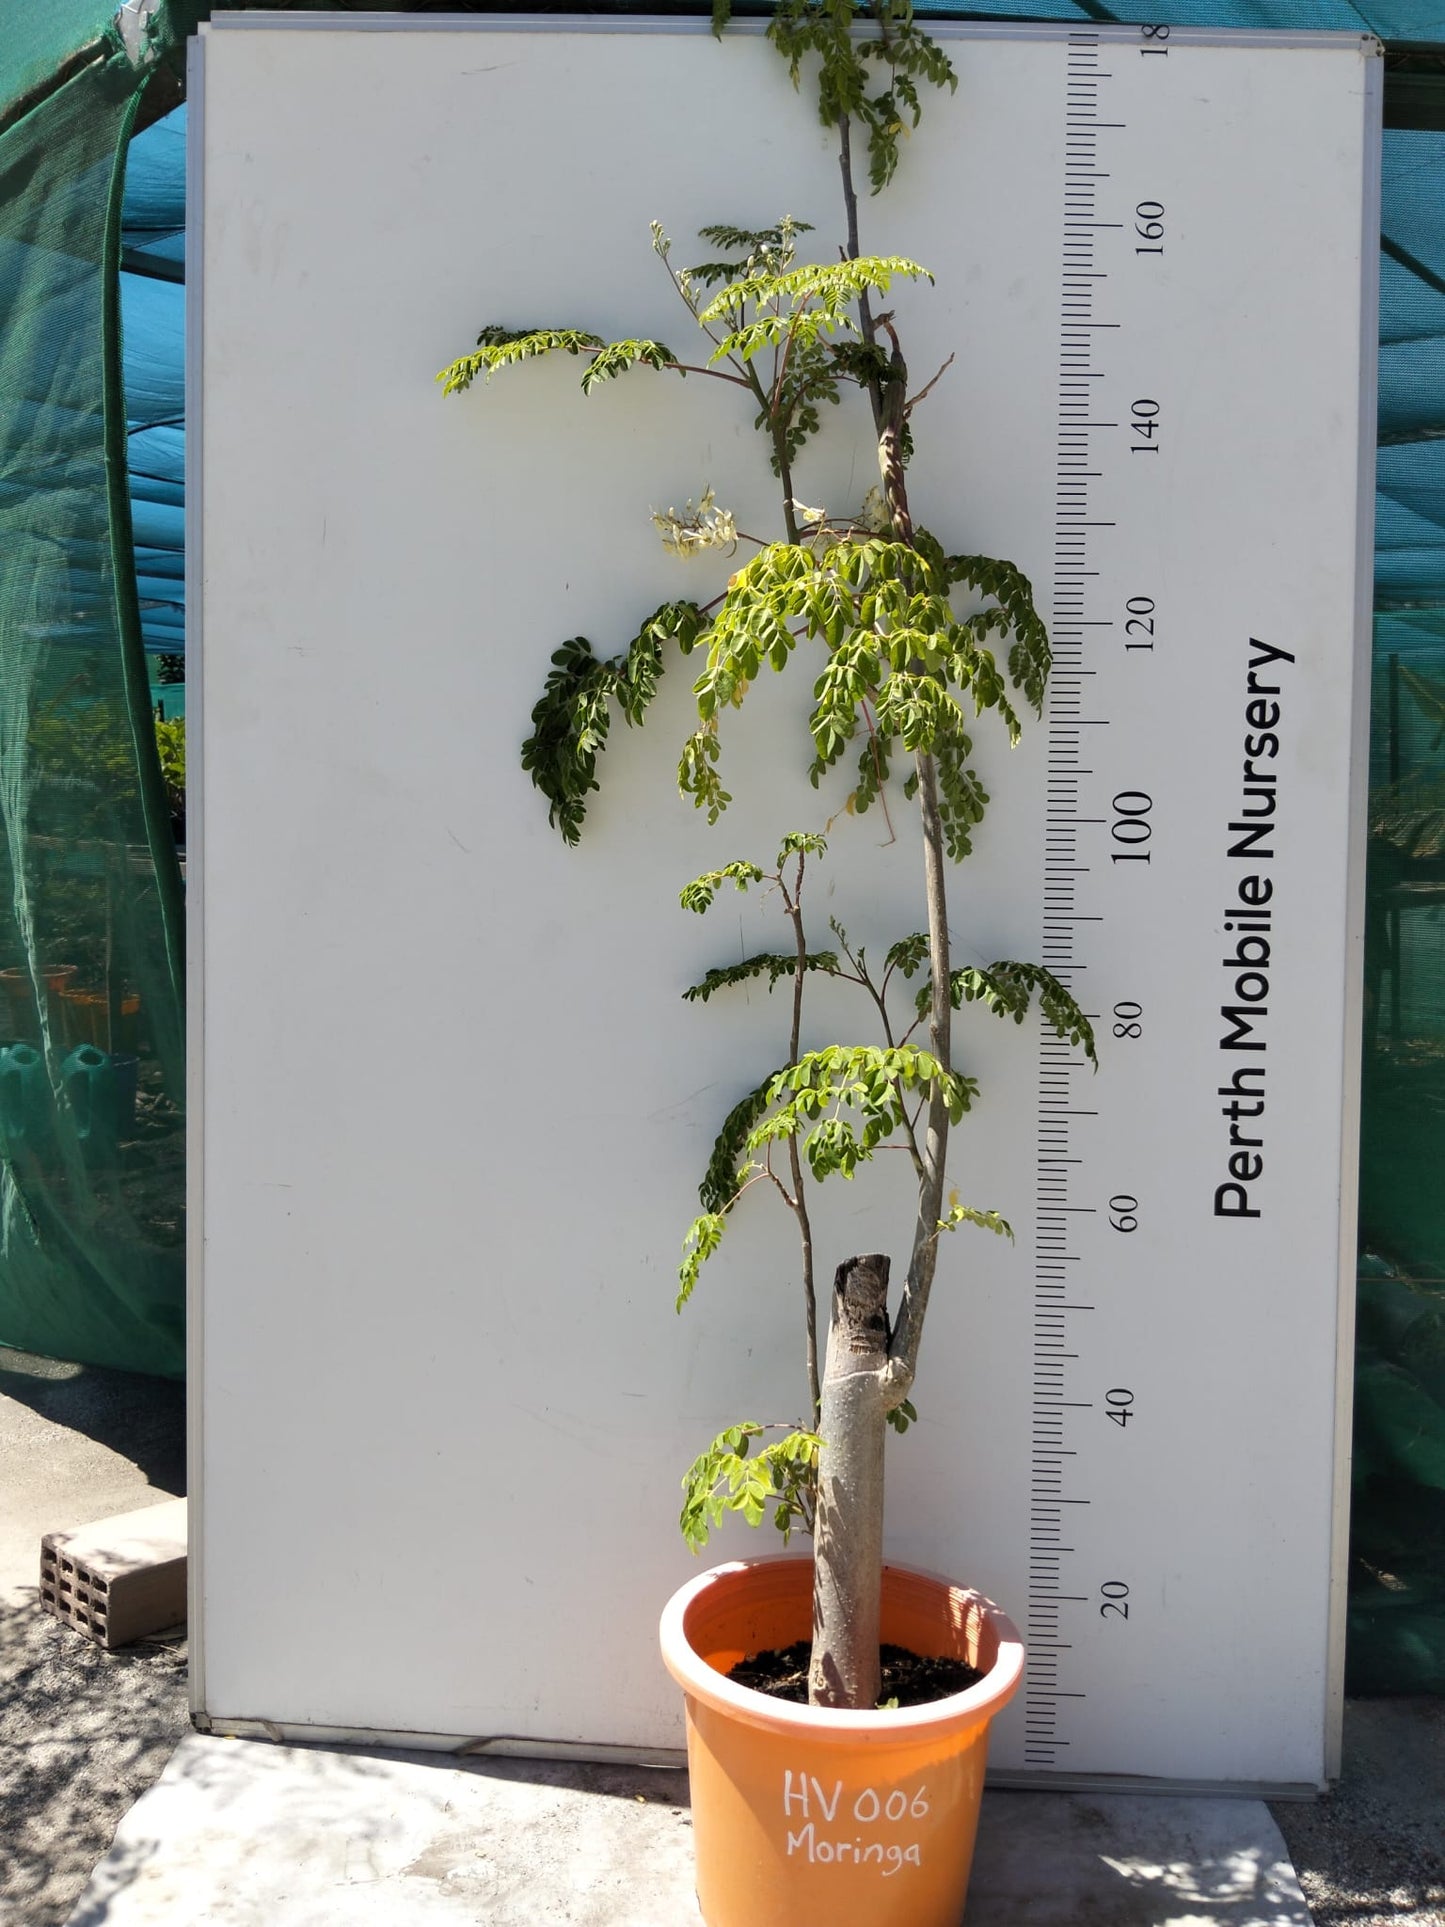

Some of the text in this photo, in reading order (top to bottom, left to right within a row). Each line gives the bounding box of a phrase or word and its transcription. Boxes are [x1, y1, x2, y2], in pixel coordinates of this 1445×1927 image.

[1134, 200, 1165, 257] 160
[1130, 398, 1160, 455] 140
[1124, 596, 1155, 653] 120
[1110, 790, 1153, 866] 100
[1213, 637, 1296, 1219] Perth Mobile Nursery
[1112, 1000, 1143, 1040] 80
[1108, 1193, 1139, 1233] 60
[1104, 1387, 1135, 1428] 40
[1099, 1580, 1130, 1621] 20
[783, 1769, 930, 1823] HV 006
[786, 1822, 921, 1876] Moringa
